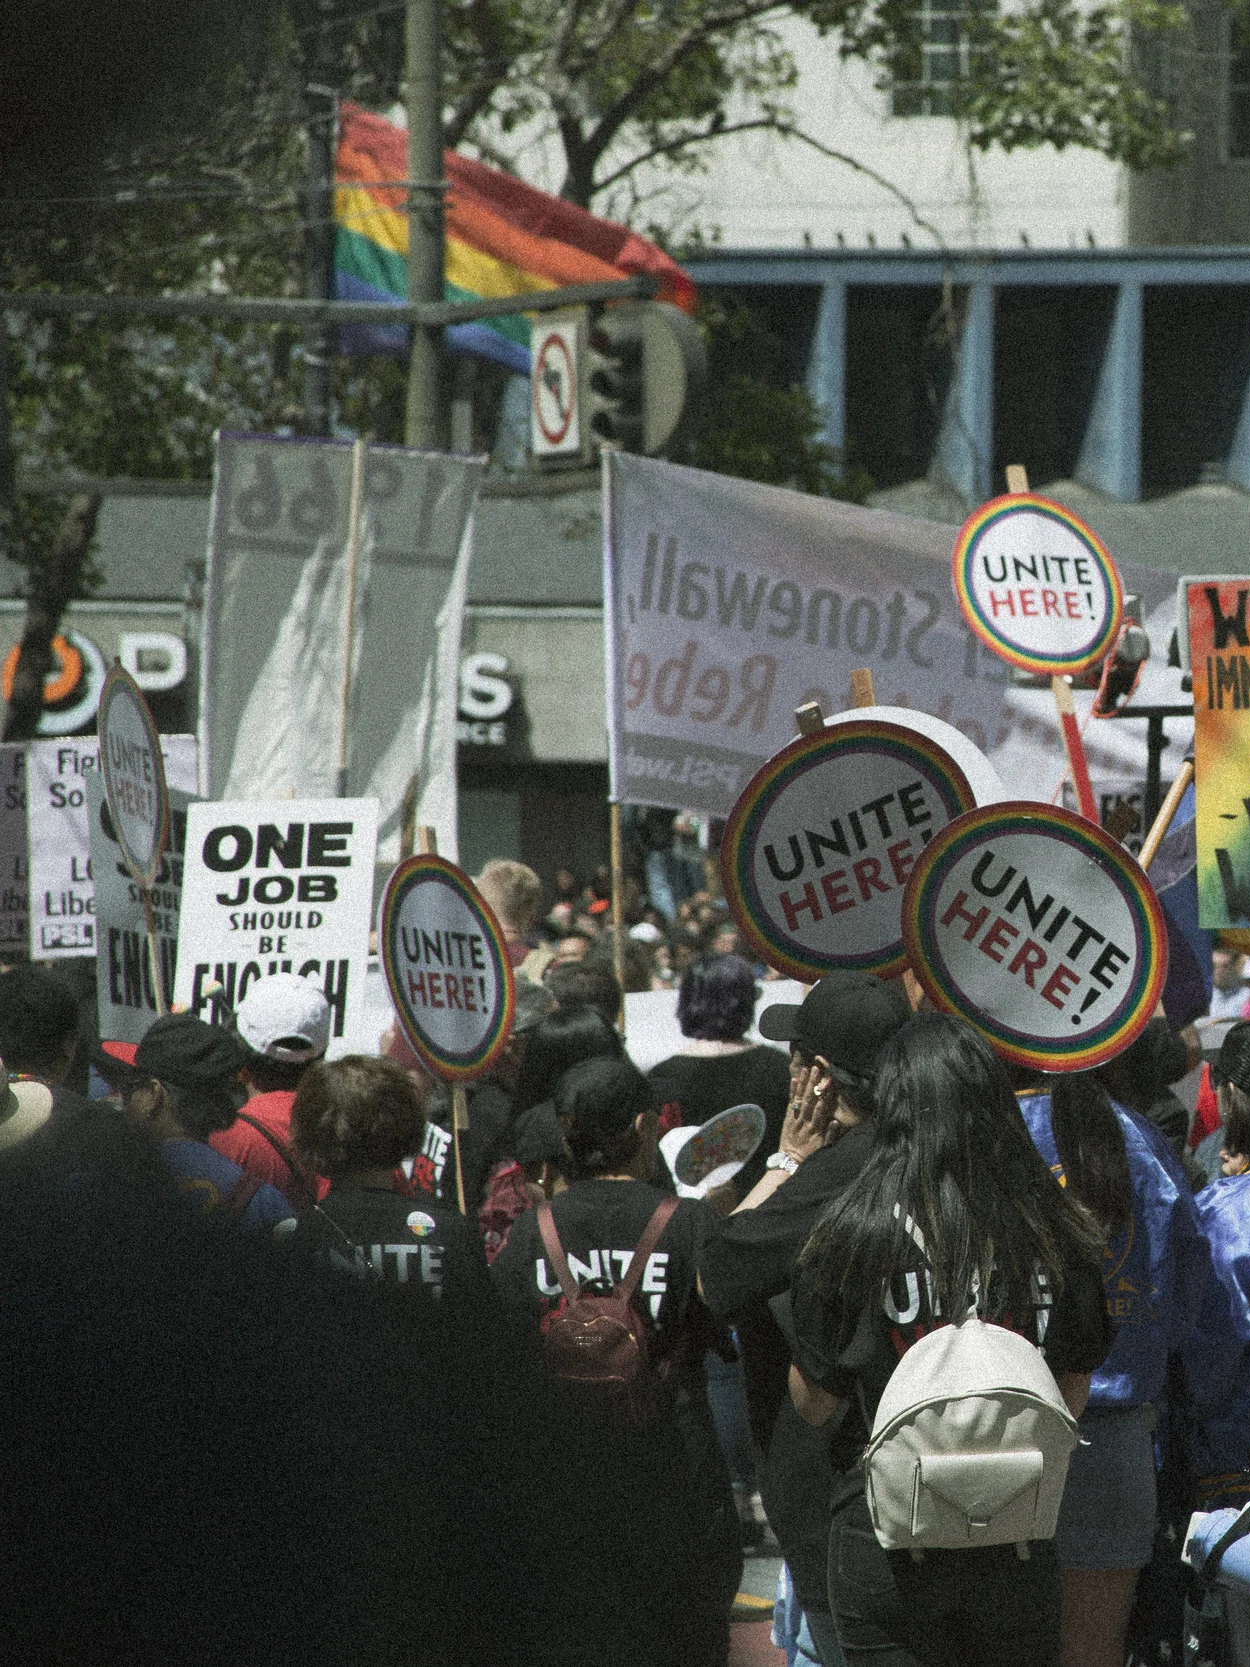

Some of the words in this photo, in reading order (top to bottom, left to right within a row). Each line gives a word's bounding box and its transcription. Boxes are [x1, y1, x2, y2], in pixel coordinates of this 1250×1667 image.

[983, 554, 1093, 586] UNITE
[989, 588, 1097, 622] HERE!
[202, 822, 354, 873] ONE
[763, 781, 933, 883] UNITE
[216, 874, 338, 906] JOB
[228, 911, 323, 931] SHOULD
[970, 850, 1130, 990] UNITE
[258, 935, 288, 954] BE
[402, 928, 486, 970] UNITE
[940, 891, 1102, 1026] HERE!
[406, 973, 489, 1015] HERE!
